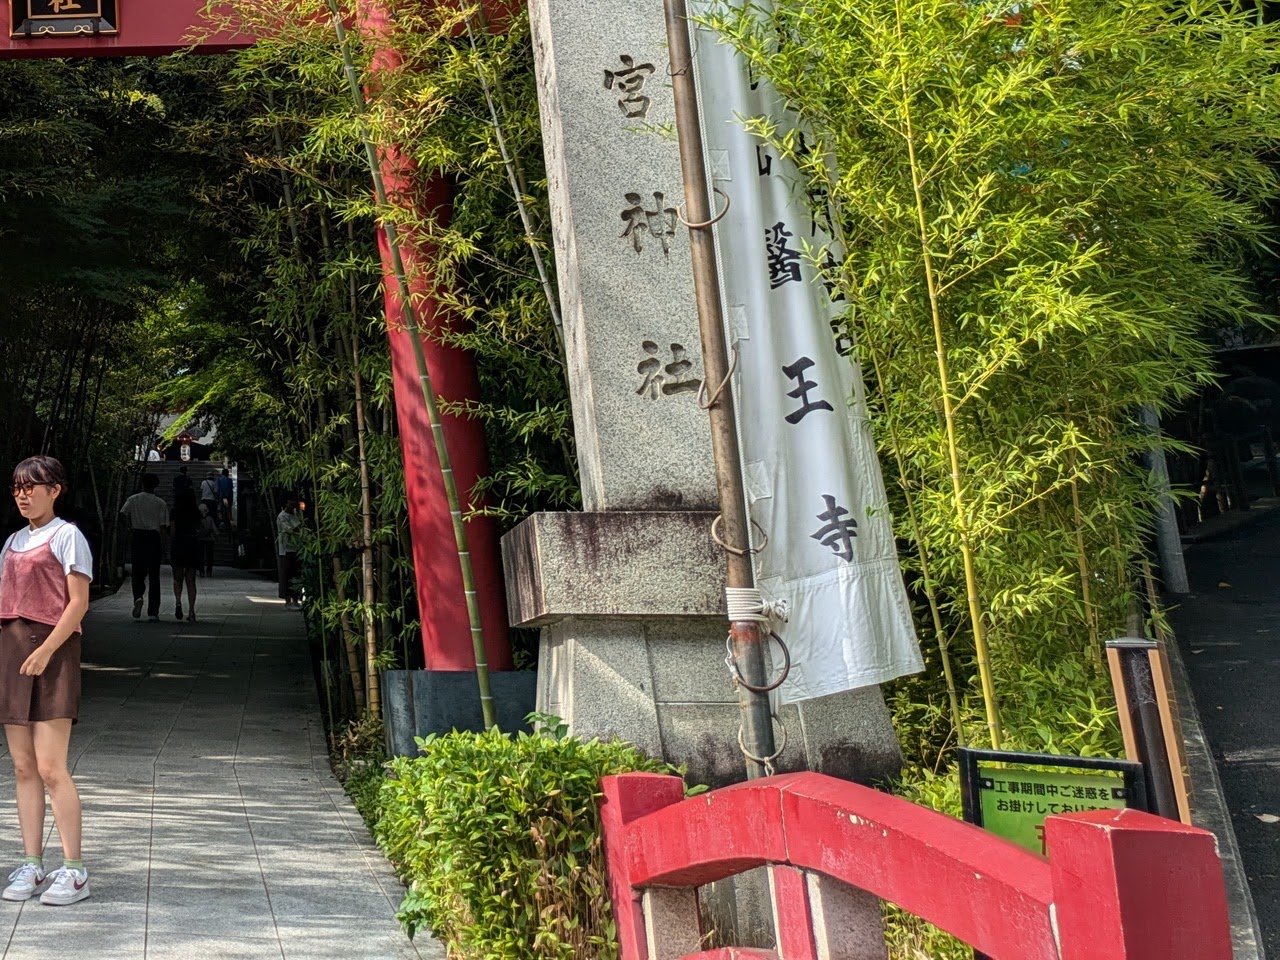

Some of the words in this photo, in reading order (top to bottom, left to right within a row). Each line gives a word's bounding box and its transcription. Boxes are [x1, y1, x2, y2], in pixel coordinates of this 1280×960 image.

[995, 780, 1110, 800] 工事期間中ご迷惑を
[996, 799, 1111, 814] お掛けしており
